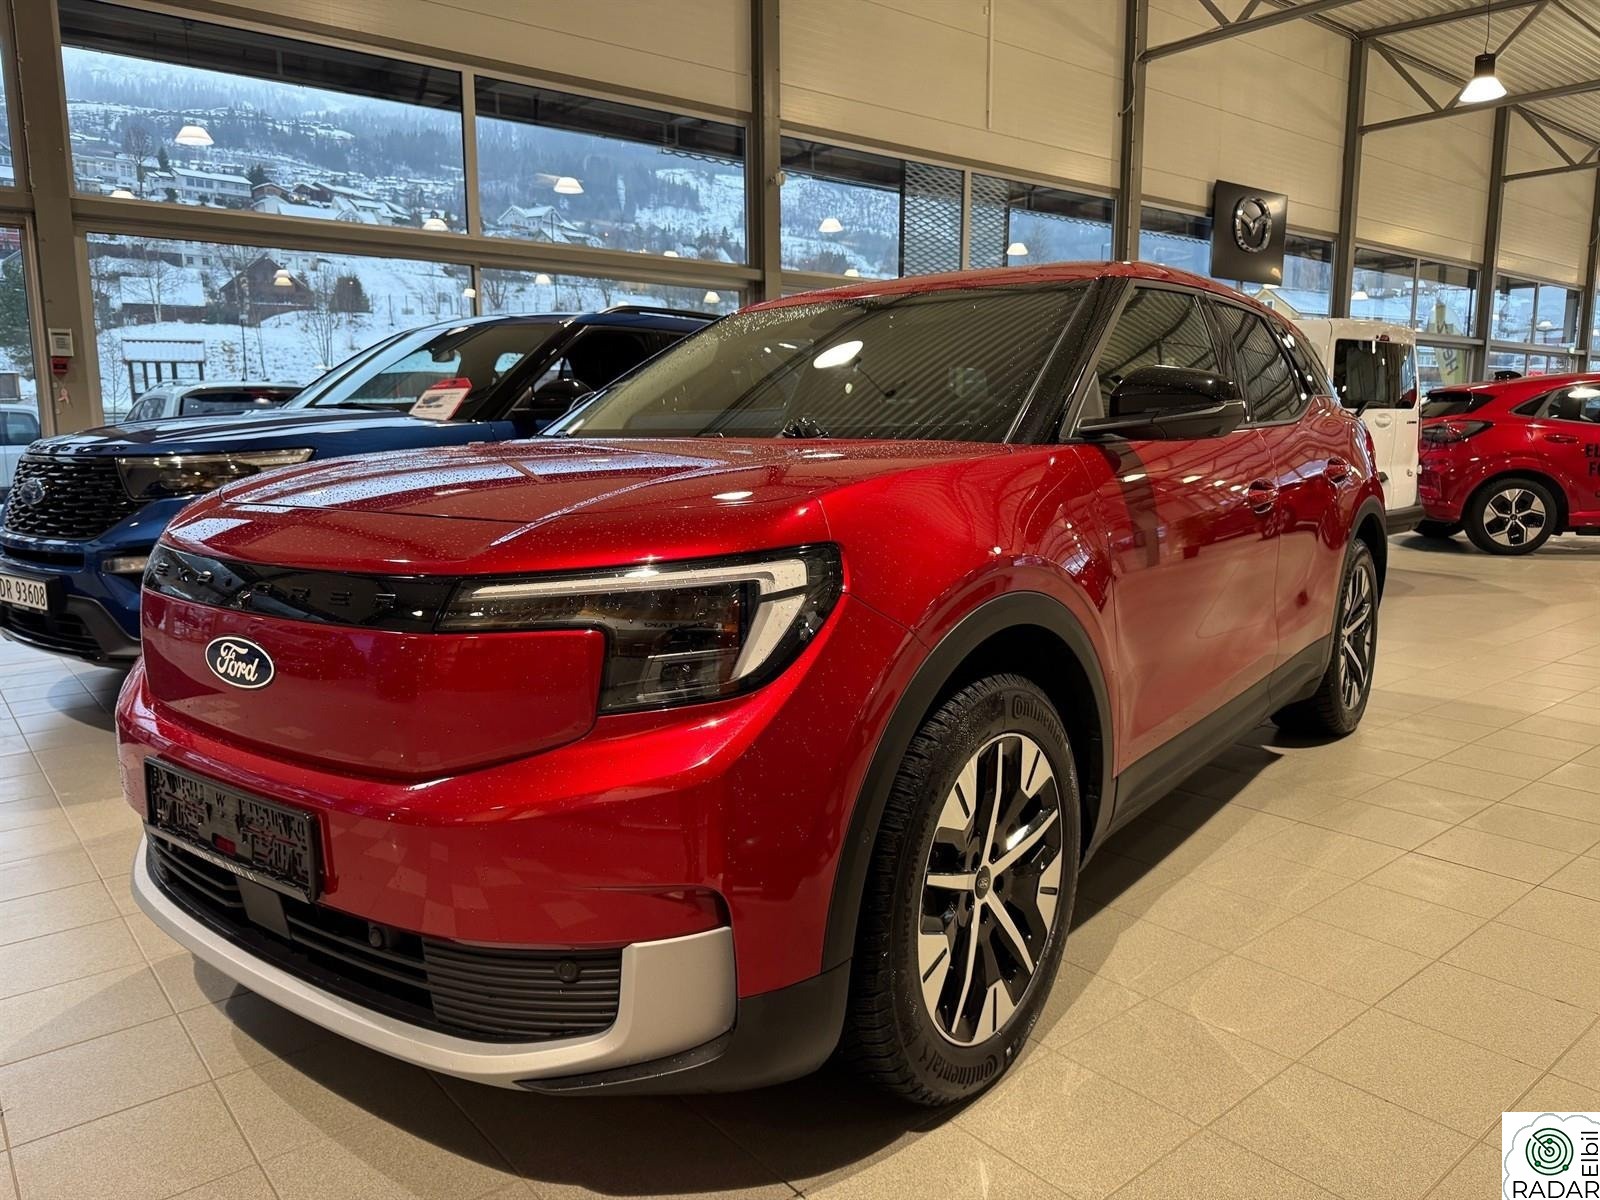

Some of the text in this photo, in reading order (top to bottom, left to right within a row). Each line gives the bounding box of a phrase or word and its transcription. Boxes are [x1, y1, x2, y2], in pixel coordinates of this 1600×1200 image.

[15, 581, 46, 607] 93608
[216, 642, 260, 682] Ford
[925, 1049, 998, 1090] Continental
